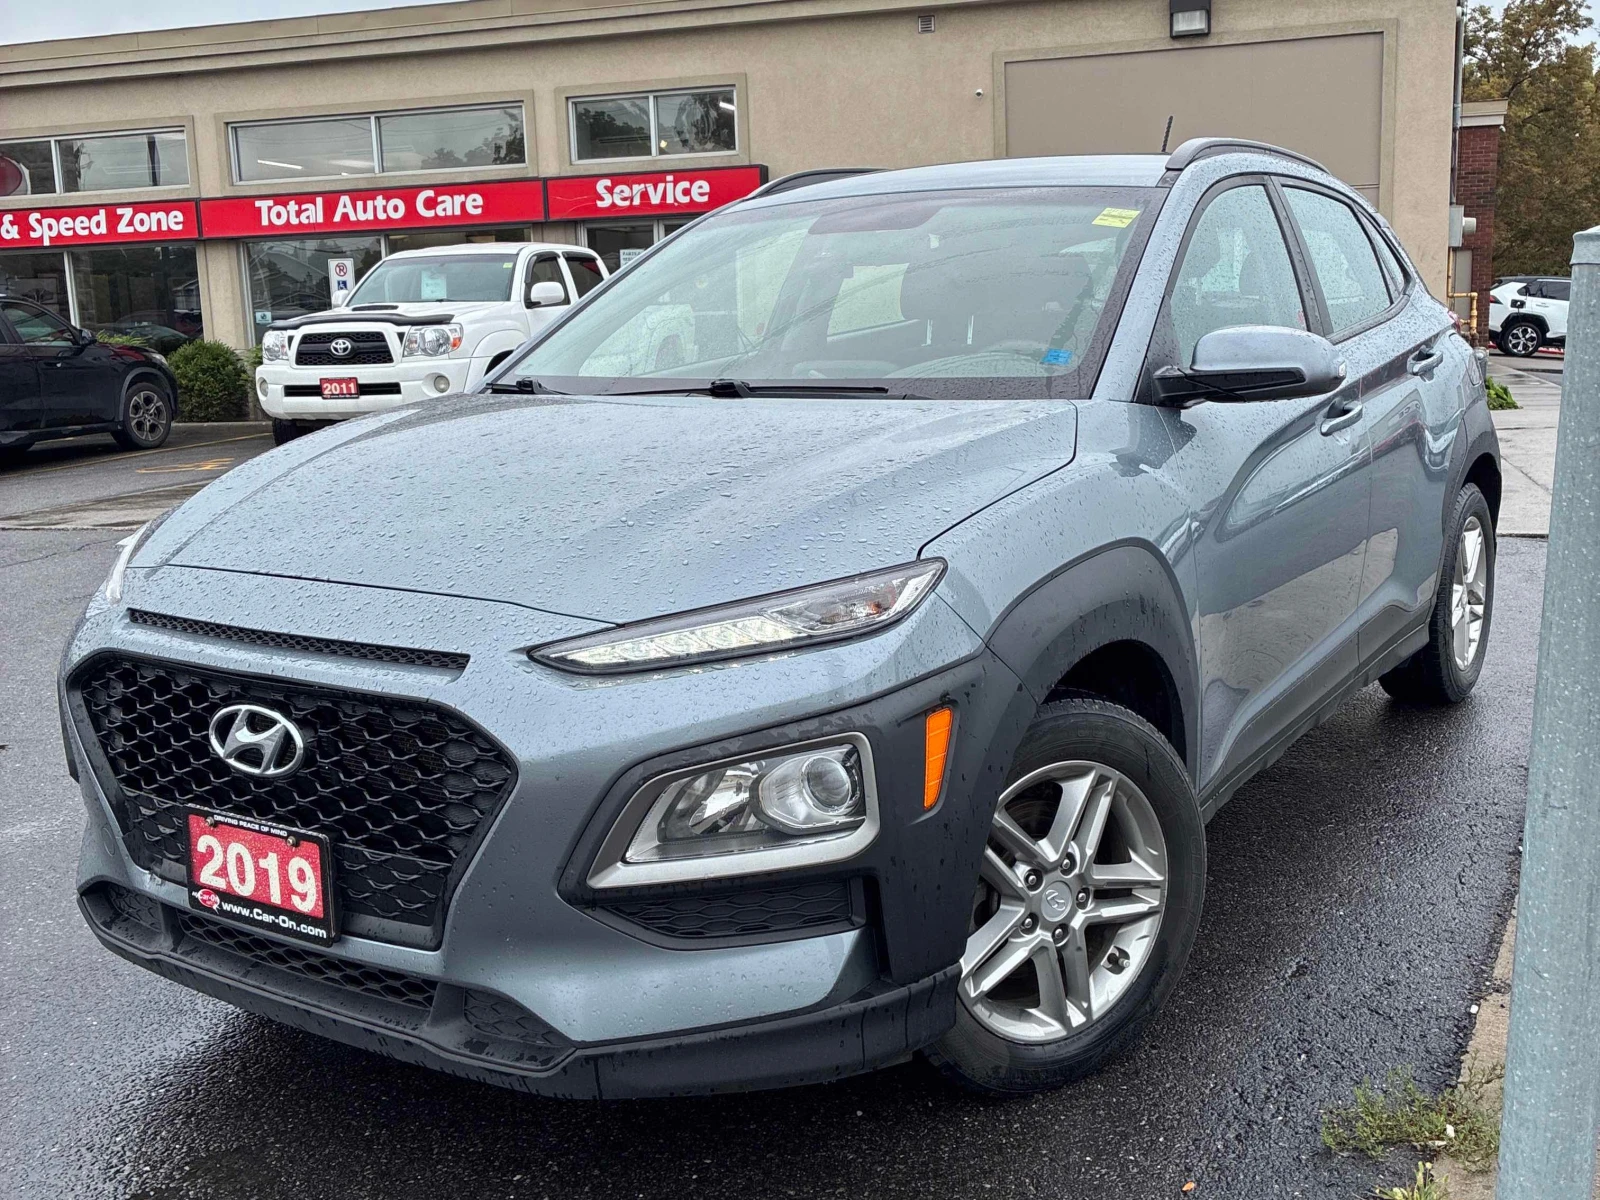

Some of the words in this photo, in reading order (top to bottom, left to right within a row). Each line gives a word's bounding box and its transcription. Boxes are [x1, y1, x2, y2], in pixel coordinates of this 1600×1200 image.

[255, 197, 324, 226] Total
[333, 195, 405, 222] Auto
[416, 190, 483, 218] Care
[596, 175, 710, 208] Service
[1, 213, 20, 240] &
[28, 209, 107, 246] Speed
[116, 207, 184, 233] Zone
[323, 382, 355, 395] 2011
[213, 814, 238, 825] DRIVING
[239, 820, 259, 830] PEACE
[270, 827, 287, 837] MIND
[197, 834, 316, 912] 2019
[222, 902, 327, 939] www.Car-On.com
